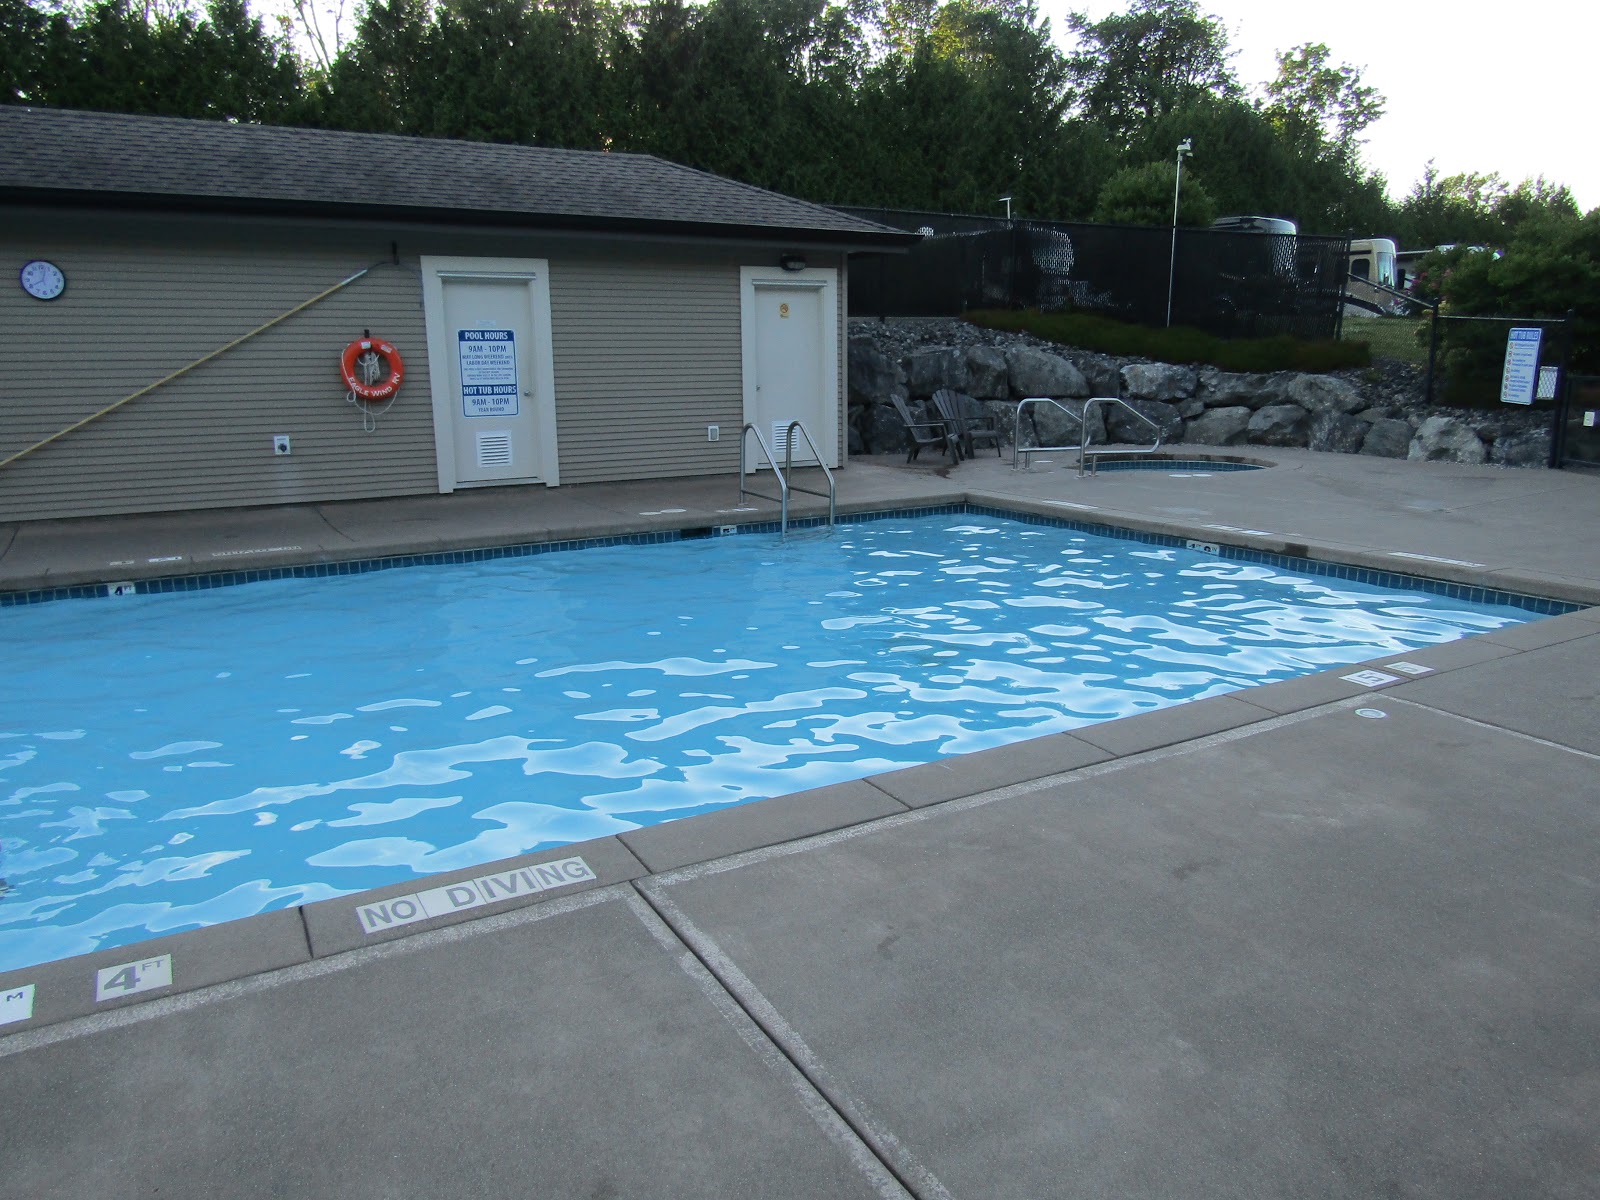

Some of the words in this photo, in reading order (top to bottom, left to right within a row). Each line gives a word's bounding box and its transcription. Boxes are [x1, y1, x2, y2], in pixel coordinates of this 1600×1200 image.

[464, 332, 484, 340] POOL
[484, 332, 508, 340] HOURS
[348, 376, 369, 396] EAGLE
[371, 386, 392, 396] WIND
[392, 372, 400, 384] RV
[363, 899, 417, 928] NO
[445, 860, 590, 908] DIVING
[104, 966, 140, 990] 4
[142, 959, 164, 972] FT
[6, 992, 24, 1002] M
